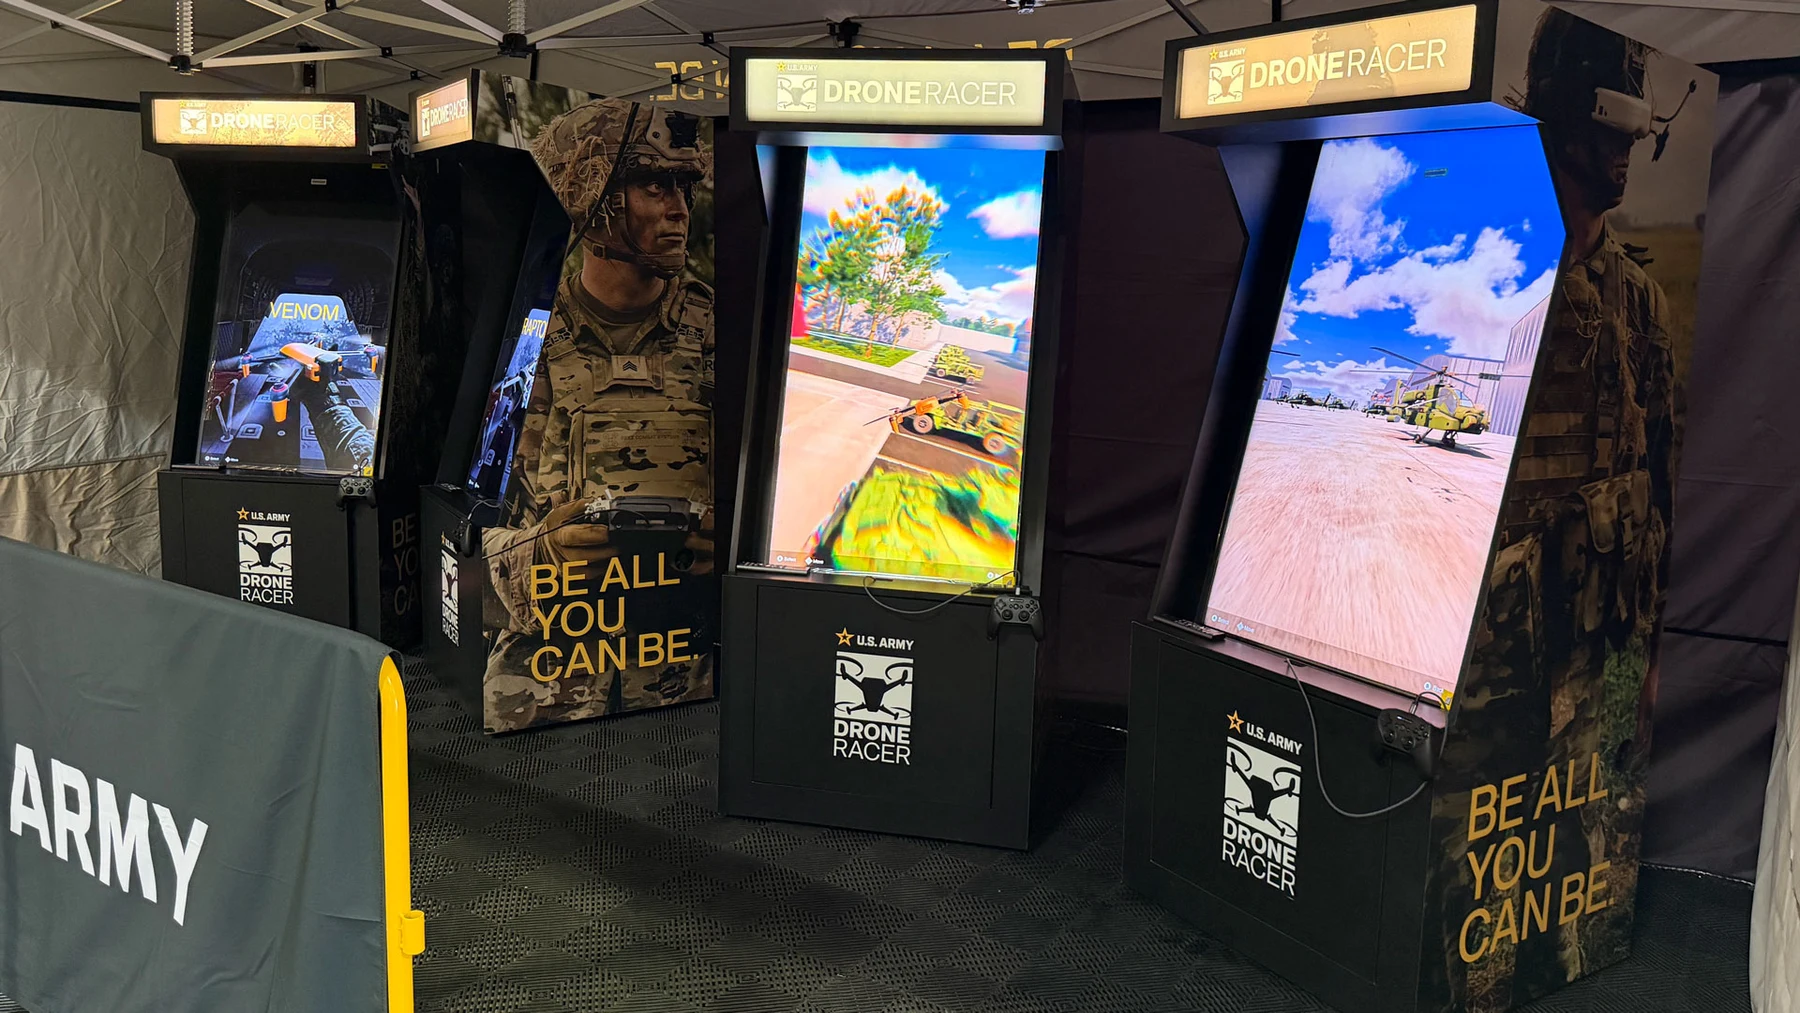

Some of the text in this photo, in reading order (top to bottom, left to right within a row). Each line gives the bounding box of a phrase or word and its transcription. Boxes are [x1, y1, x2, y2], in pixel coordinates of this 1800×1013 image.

[270, 301, 339, 321] VENOM
[521, 317, 548, 339] RAPTO
[251, 511, 291, 522] U.S. ARMY
[392, 512, 417, 549] BE
[394, 546, 419, 581] YO
[530, 552, 681, 600] BE ALL
[240, 574, 292, 590] DRONE
[240, 587, 294, 605] RACER
[394, 582, 419, 616] CA
[531, 596, 625, 641] YOU
[530, 628, 699, 682] CAN BE.
[857, 635, 914, 651] U.S. ARMY
[834, 719, 911, 745] DRONE
[1246, 722, 1303, 756] U.S. ARMY
[833, 738, 911, 765] RACER
[1467, 751, 1609, 842] BE ALL
[9, 743, 209, 926] ARMY
[1223, 819, 1297, 871] DRONE
[1222, 839, 1296, 896] RACER
[1467, 823, 1556, 901] YOU
[1459, 860, 1615, 964] CAN BE.
